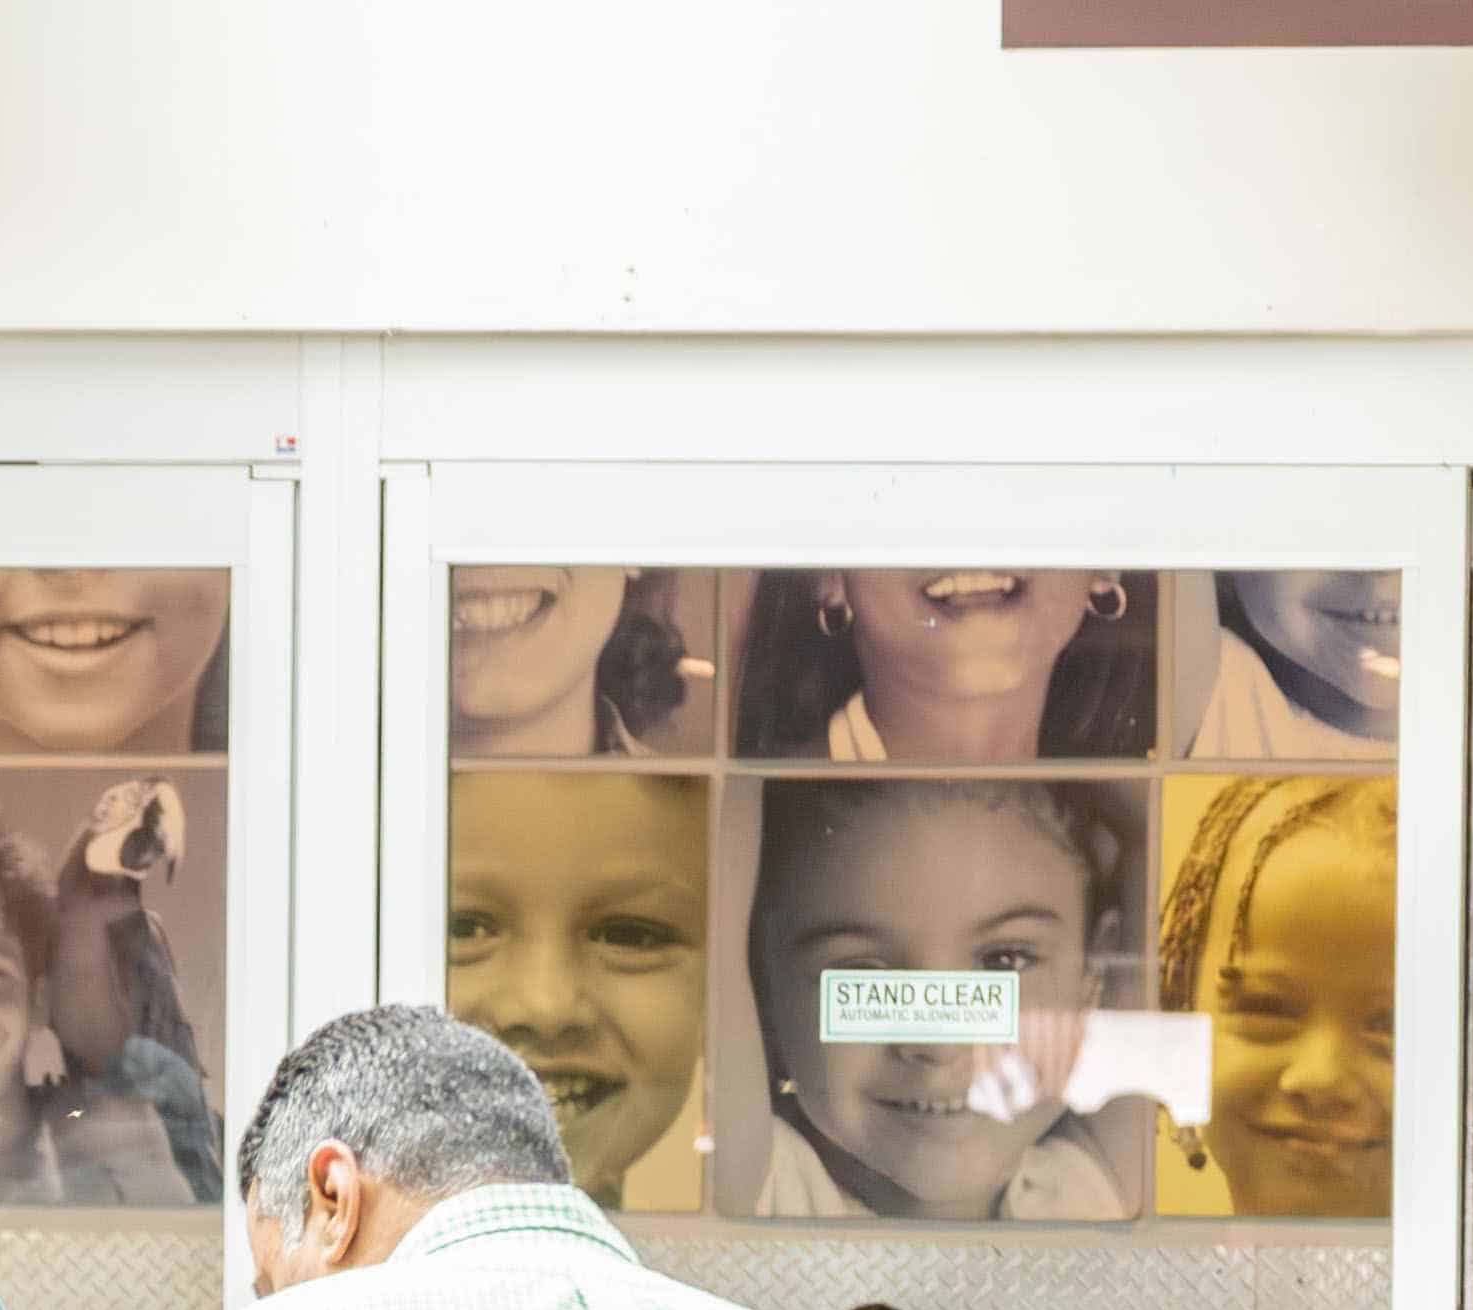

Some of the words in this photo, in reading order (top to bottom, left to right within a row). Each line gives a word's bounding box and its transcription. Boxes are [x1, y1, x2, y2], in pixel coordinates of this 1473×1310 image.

[837, 983, 916, 1006] STAND
[924, 984, 1003, 1007] CLEAR
[839, 1008, 910, 1022] AUTOMATIC
[914, 1008, 961, 1023] SLIDING
[964, 1009, 998, 1023] DOOR
